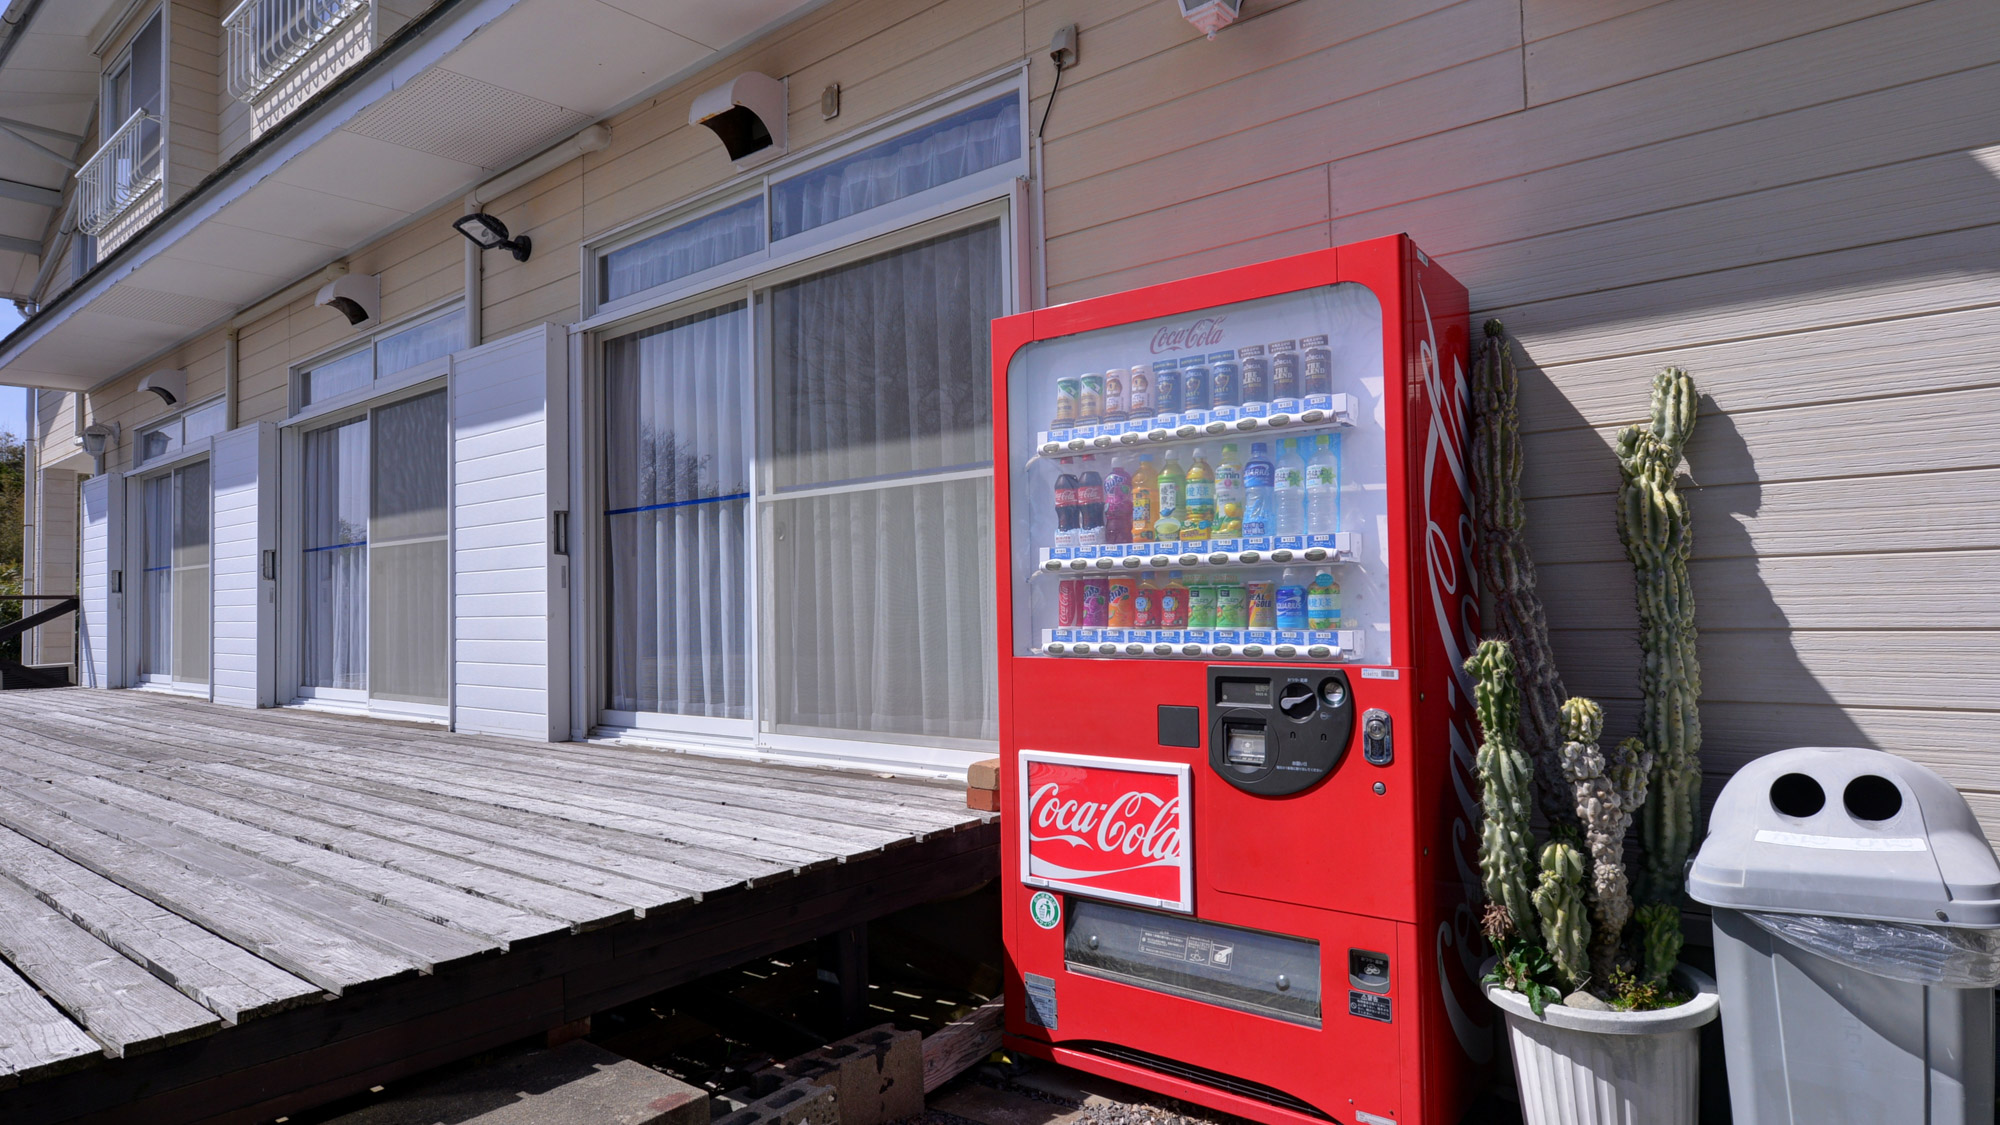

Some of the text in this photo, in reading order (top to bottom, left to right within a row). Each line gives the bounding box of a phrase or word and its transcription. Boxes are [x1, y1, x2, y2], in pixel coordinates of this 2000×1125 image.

[1149, 314, 1227, 354] Coca-Cola
[1255, 600, 1272, 608] GOLD
[1029, 782, 1181, 859] Coca-Cola
